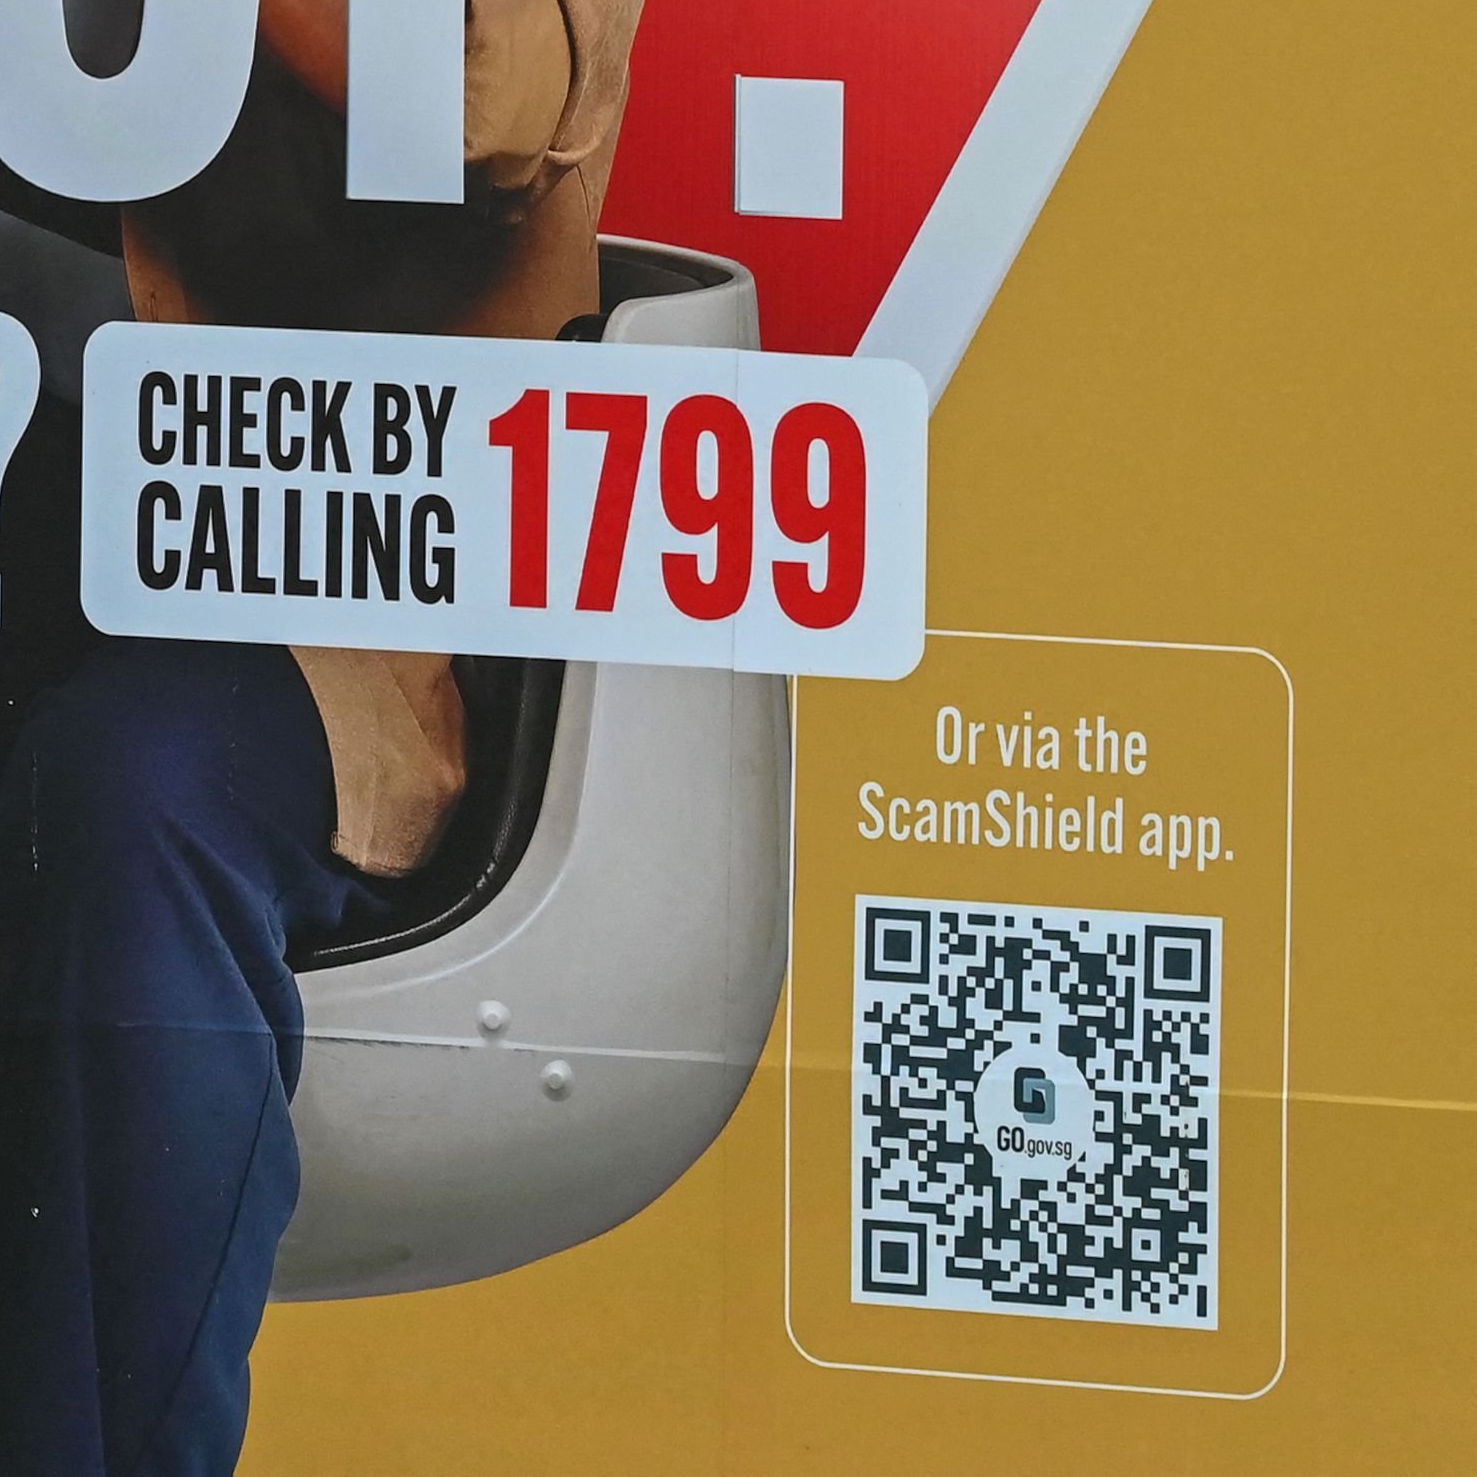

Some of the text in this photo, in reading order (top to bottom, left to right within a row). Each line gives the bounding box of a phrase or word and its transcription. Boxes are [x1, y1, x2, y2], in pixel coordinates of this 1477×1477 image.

[136, 371, 455, 478] CHECK BY
[135, 481, 456, 606] CALLING
[487, 388, 867, 632] 1799
[936, 705, 1147, 776] Or via the
[858, 781, 1234, 871] ScamShield app.
[997, 1125, 1073, 1160] GO.gov.sg
